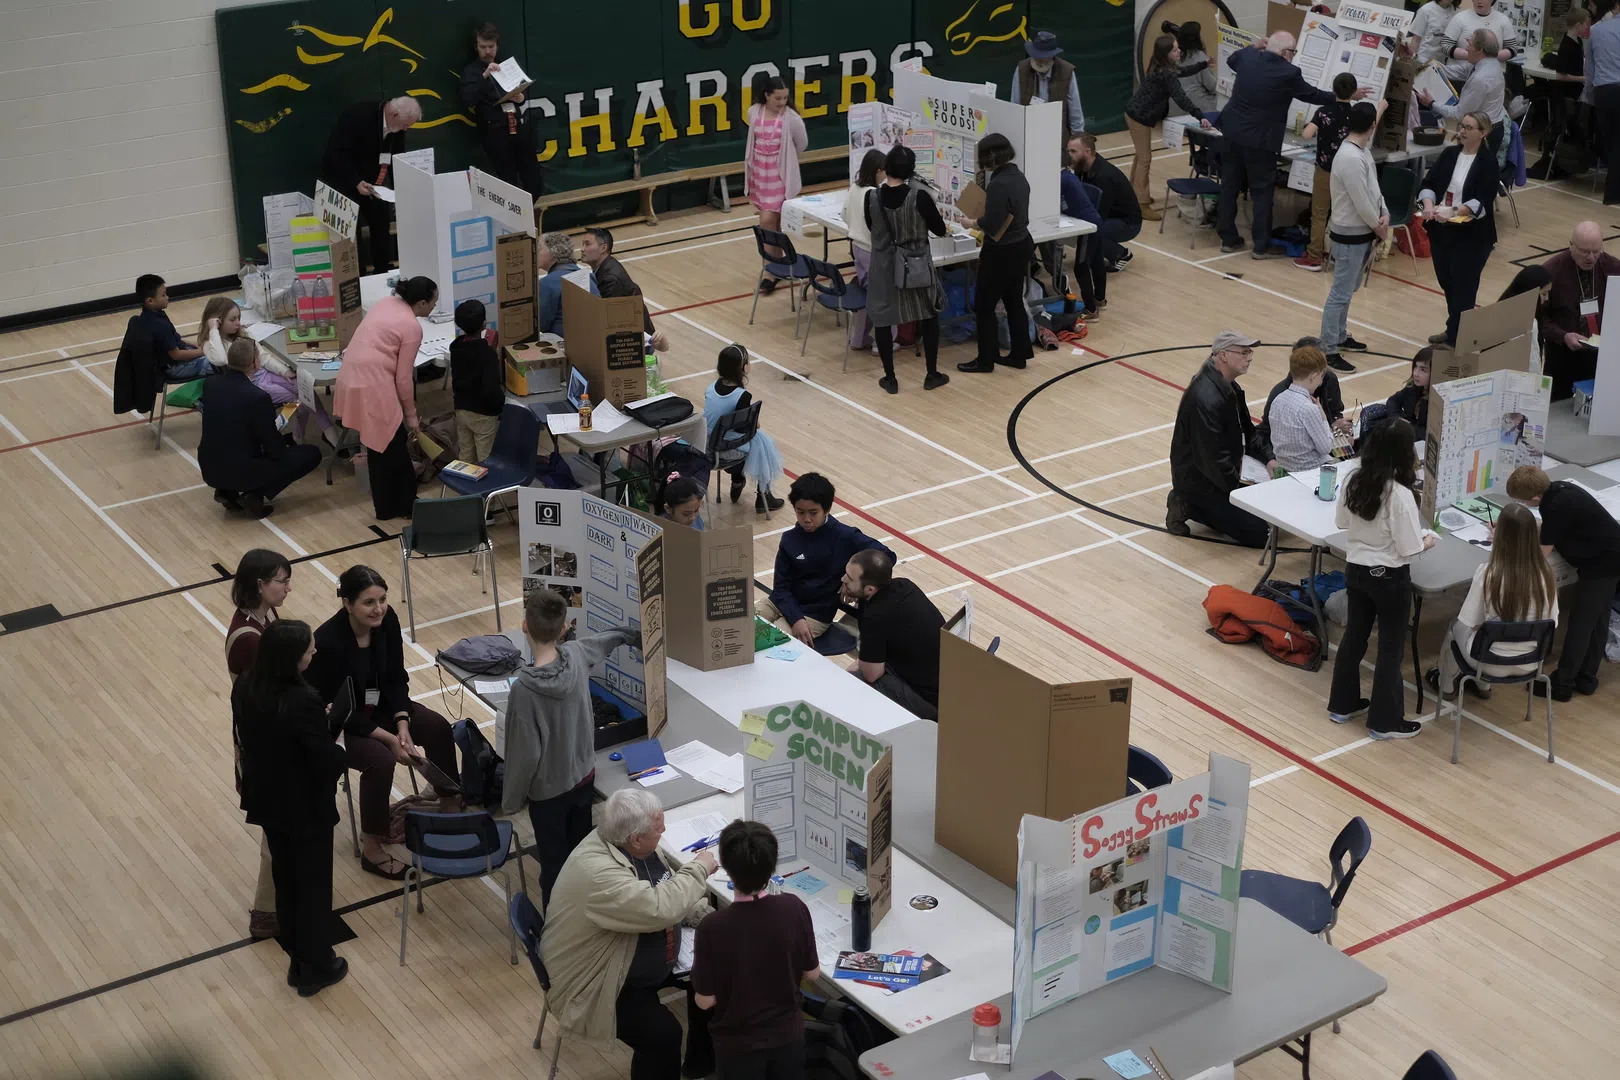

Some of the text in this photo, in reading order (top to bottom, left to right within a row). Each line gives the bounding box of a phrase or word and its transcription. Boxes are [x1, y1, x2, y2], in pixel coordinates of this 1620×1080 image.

[1345, 8, 1401, 27] POWER JUICE
[934, 98, 975, 120] SUPER
[934, 109, 975, 132] FOODS!
[327, 189, 348, 212] MASS
[476, 185, 522, 216] THE ENERGY SAVER
[322, 208, 349, 238] DAMPER
[543, 507, 553, 518] O
[585, 502, 620, 523] OXYGEN
[622, 515, 630, 526] IN
[588, 528, 627, 548] DARK &
[766, 702, 891, 765] COMPUT
[786, 732, 866, 792] SCIEN
[1081, 815, 1133, 859] Soggy
